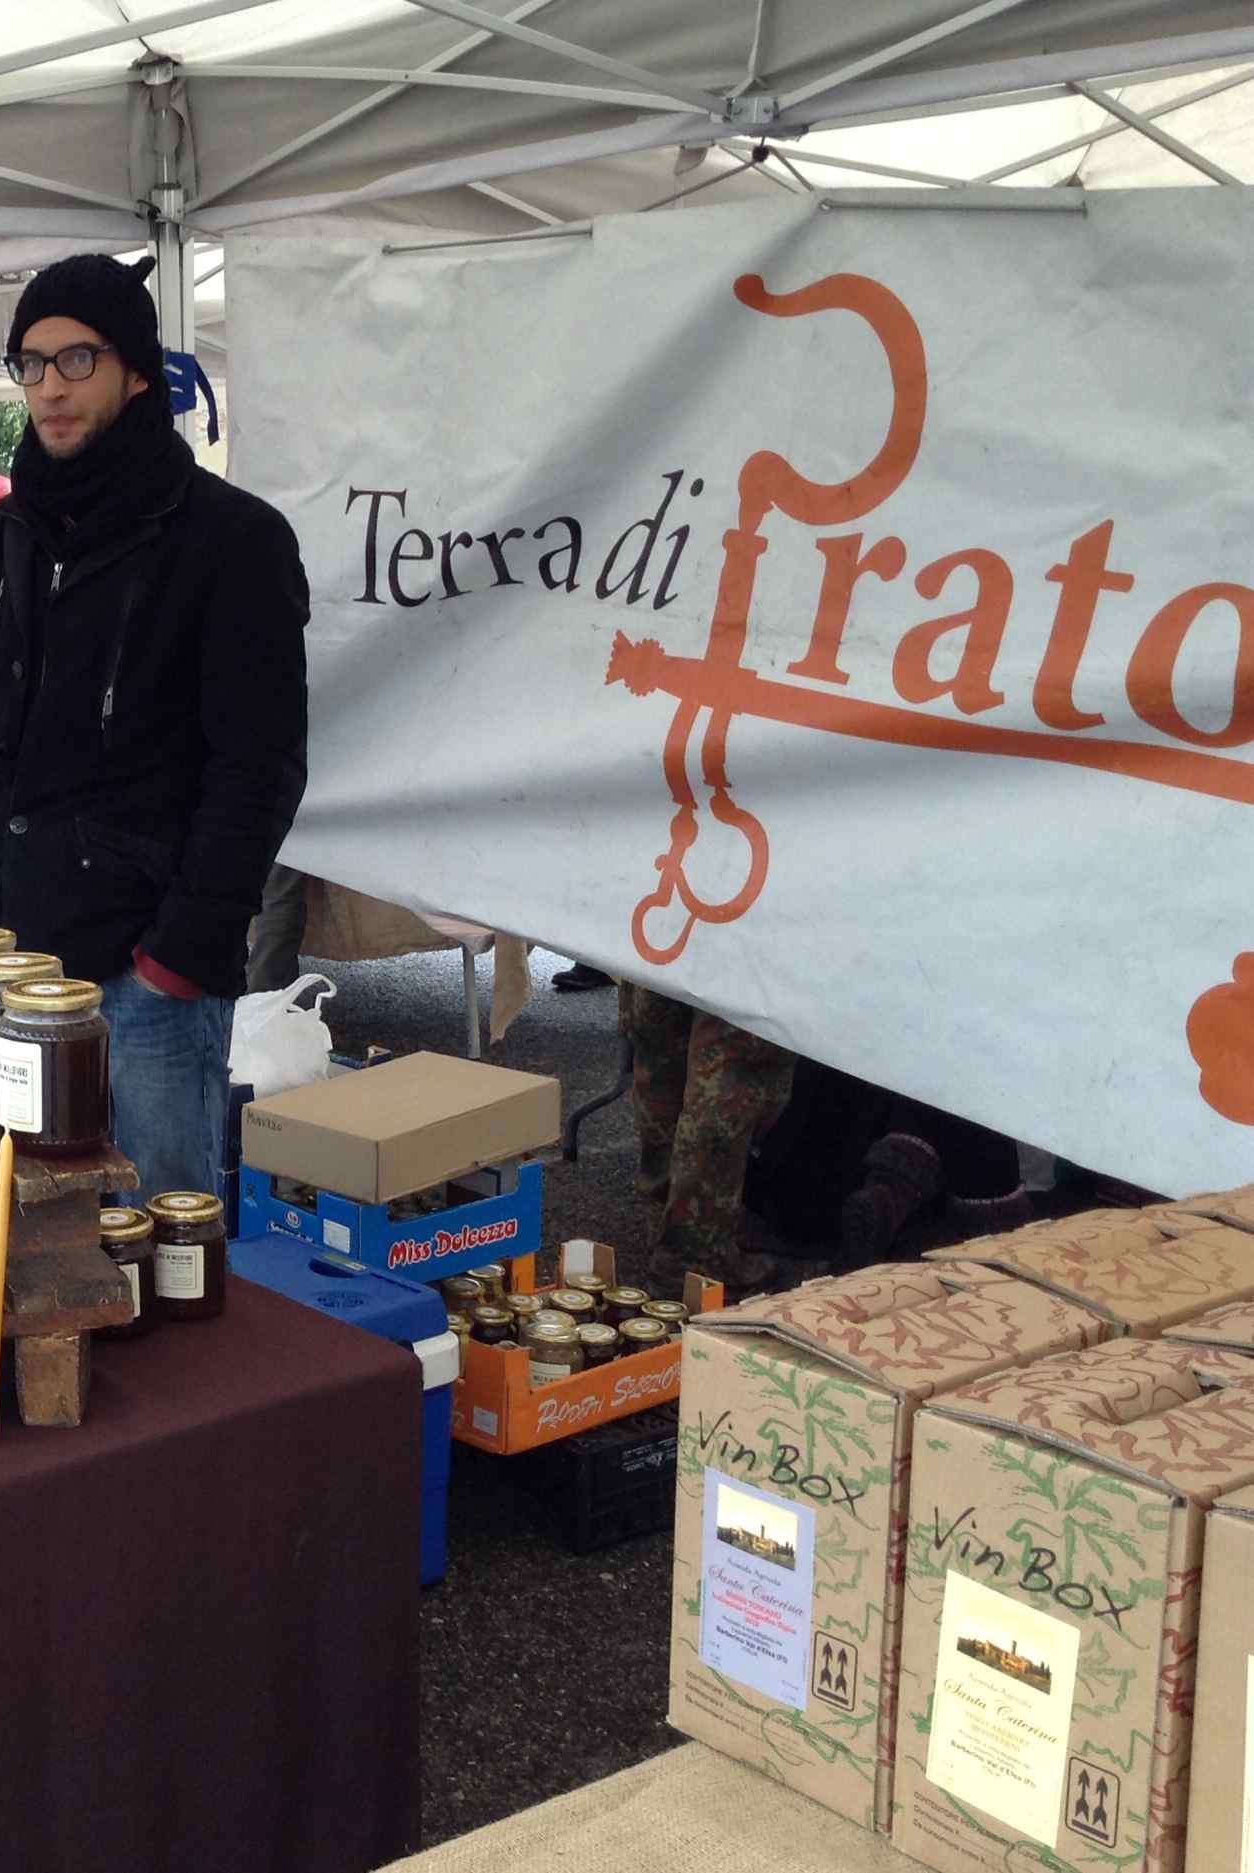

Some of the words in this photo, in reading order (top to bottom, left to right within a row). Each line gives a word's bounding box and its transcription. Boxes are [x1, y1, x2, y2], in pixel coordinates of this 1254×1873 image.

[346, 486, 583, 608] Terra
[596, 469, 704, 611] di
[704, 273, 1254, 748] Prato
[387, 1238, 433, 1270] Miss
[433, 1217, 519, 1258] Dolcezza
[698, 1410, 757, 1472] Vin
[934, 1506, 1005, 1576] Vin
[943, 1678, 987, 1710] Santa
[994, 1699, 1059, 1744] Caterina
